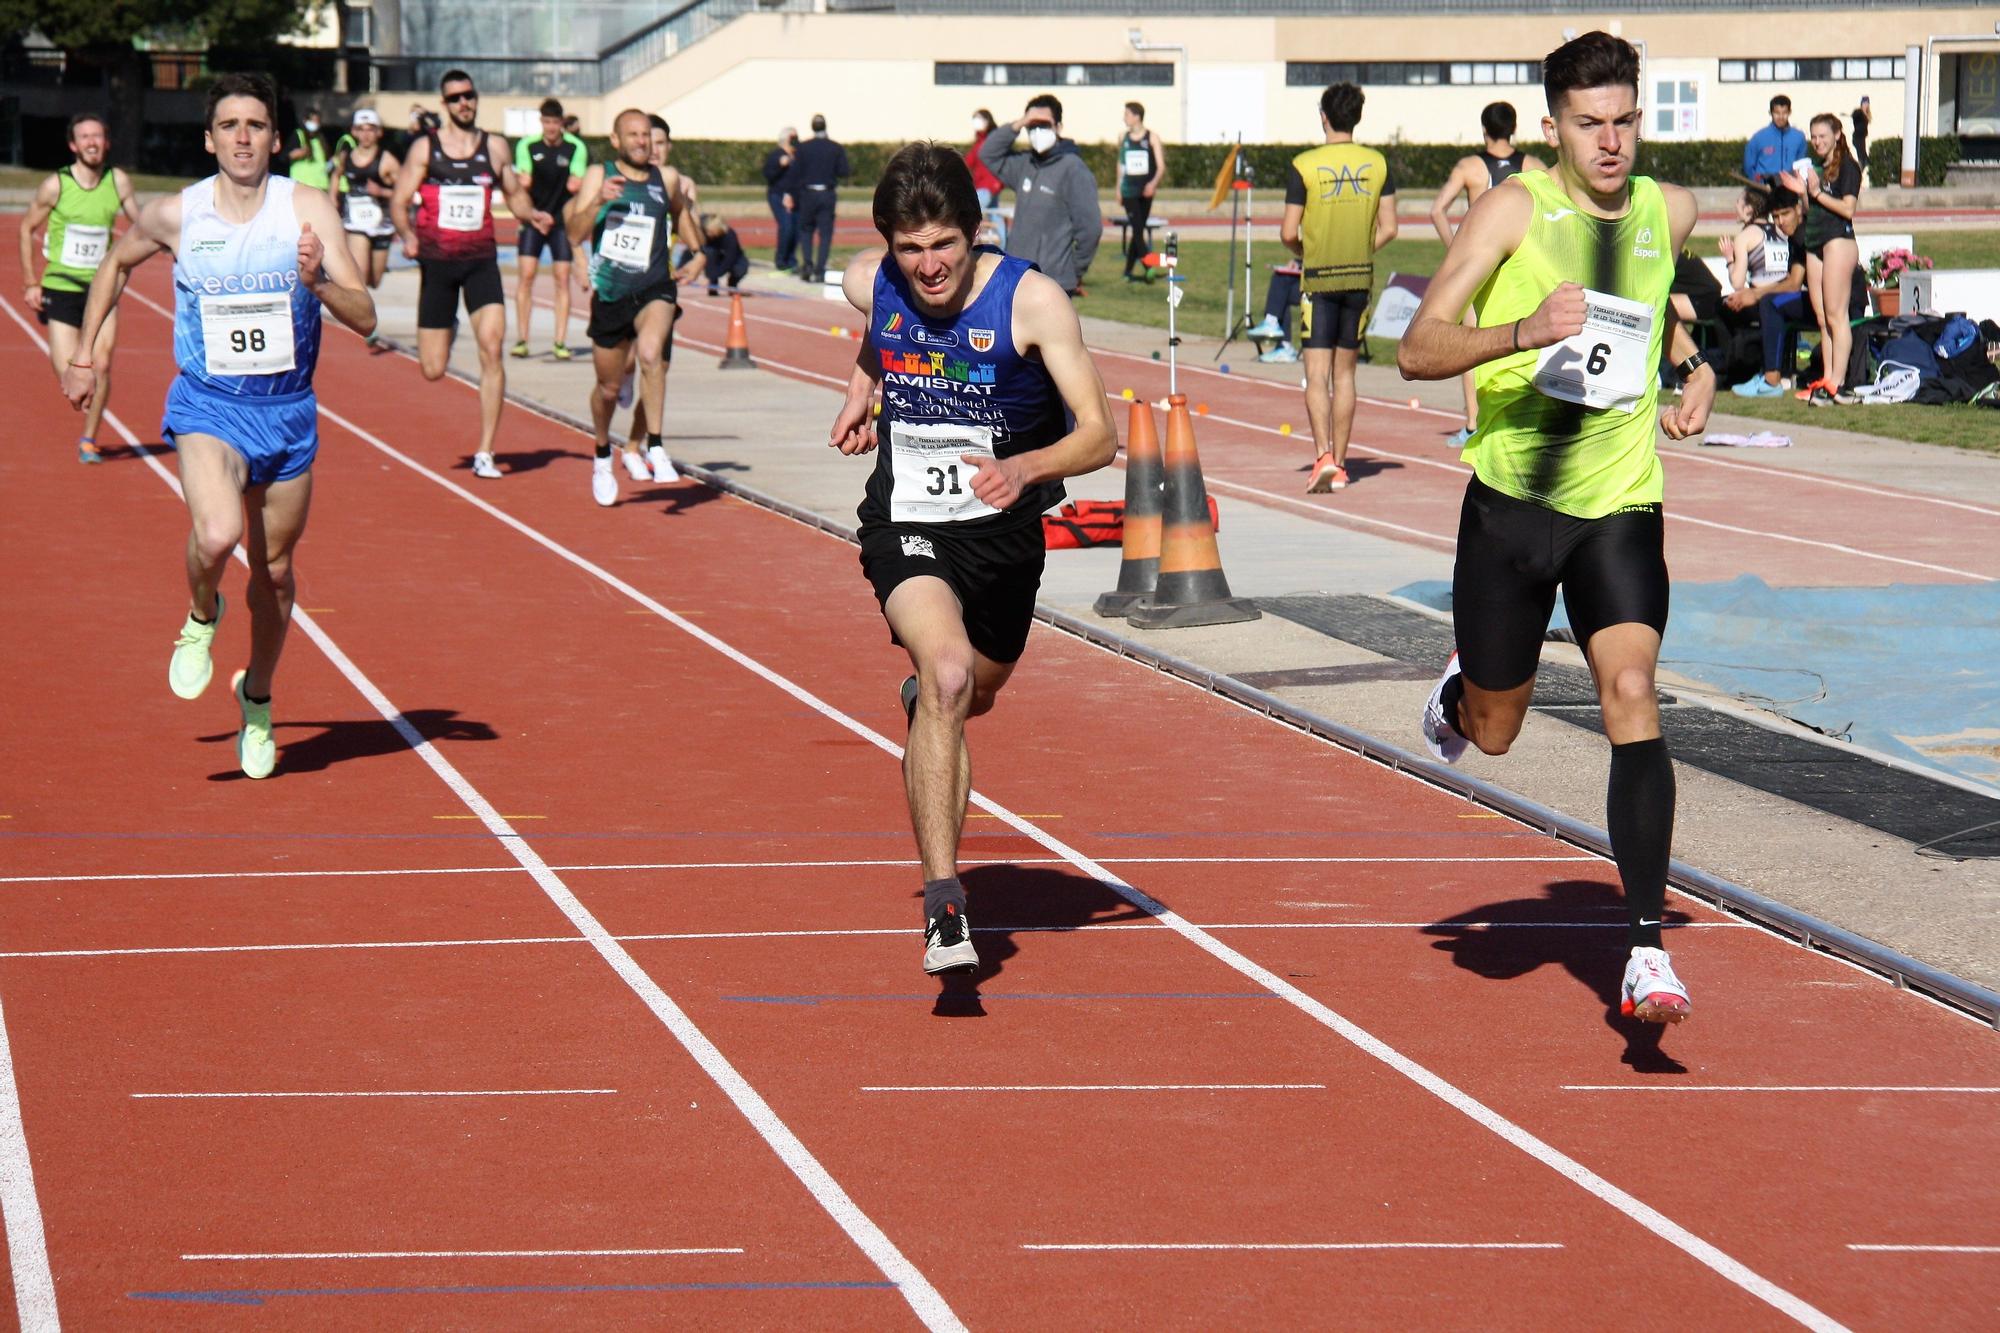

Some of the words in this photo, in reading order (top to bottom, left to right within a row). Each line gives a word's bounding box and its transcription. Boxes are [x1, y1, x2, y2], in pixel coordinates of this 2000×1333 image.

[74, 242, 98, 257] 197
[613, 232, 641, 251] 157
[231, 328, 266, 353] 98
[1586, 343, 1612, 376] 6
[884, 372, 996, 395] AMISTAT
[968, 409, 1004, 421] MAR
[926, 464, 963, 496] 31
